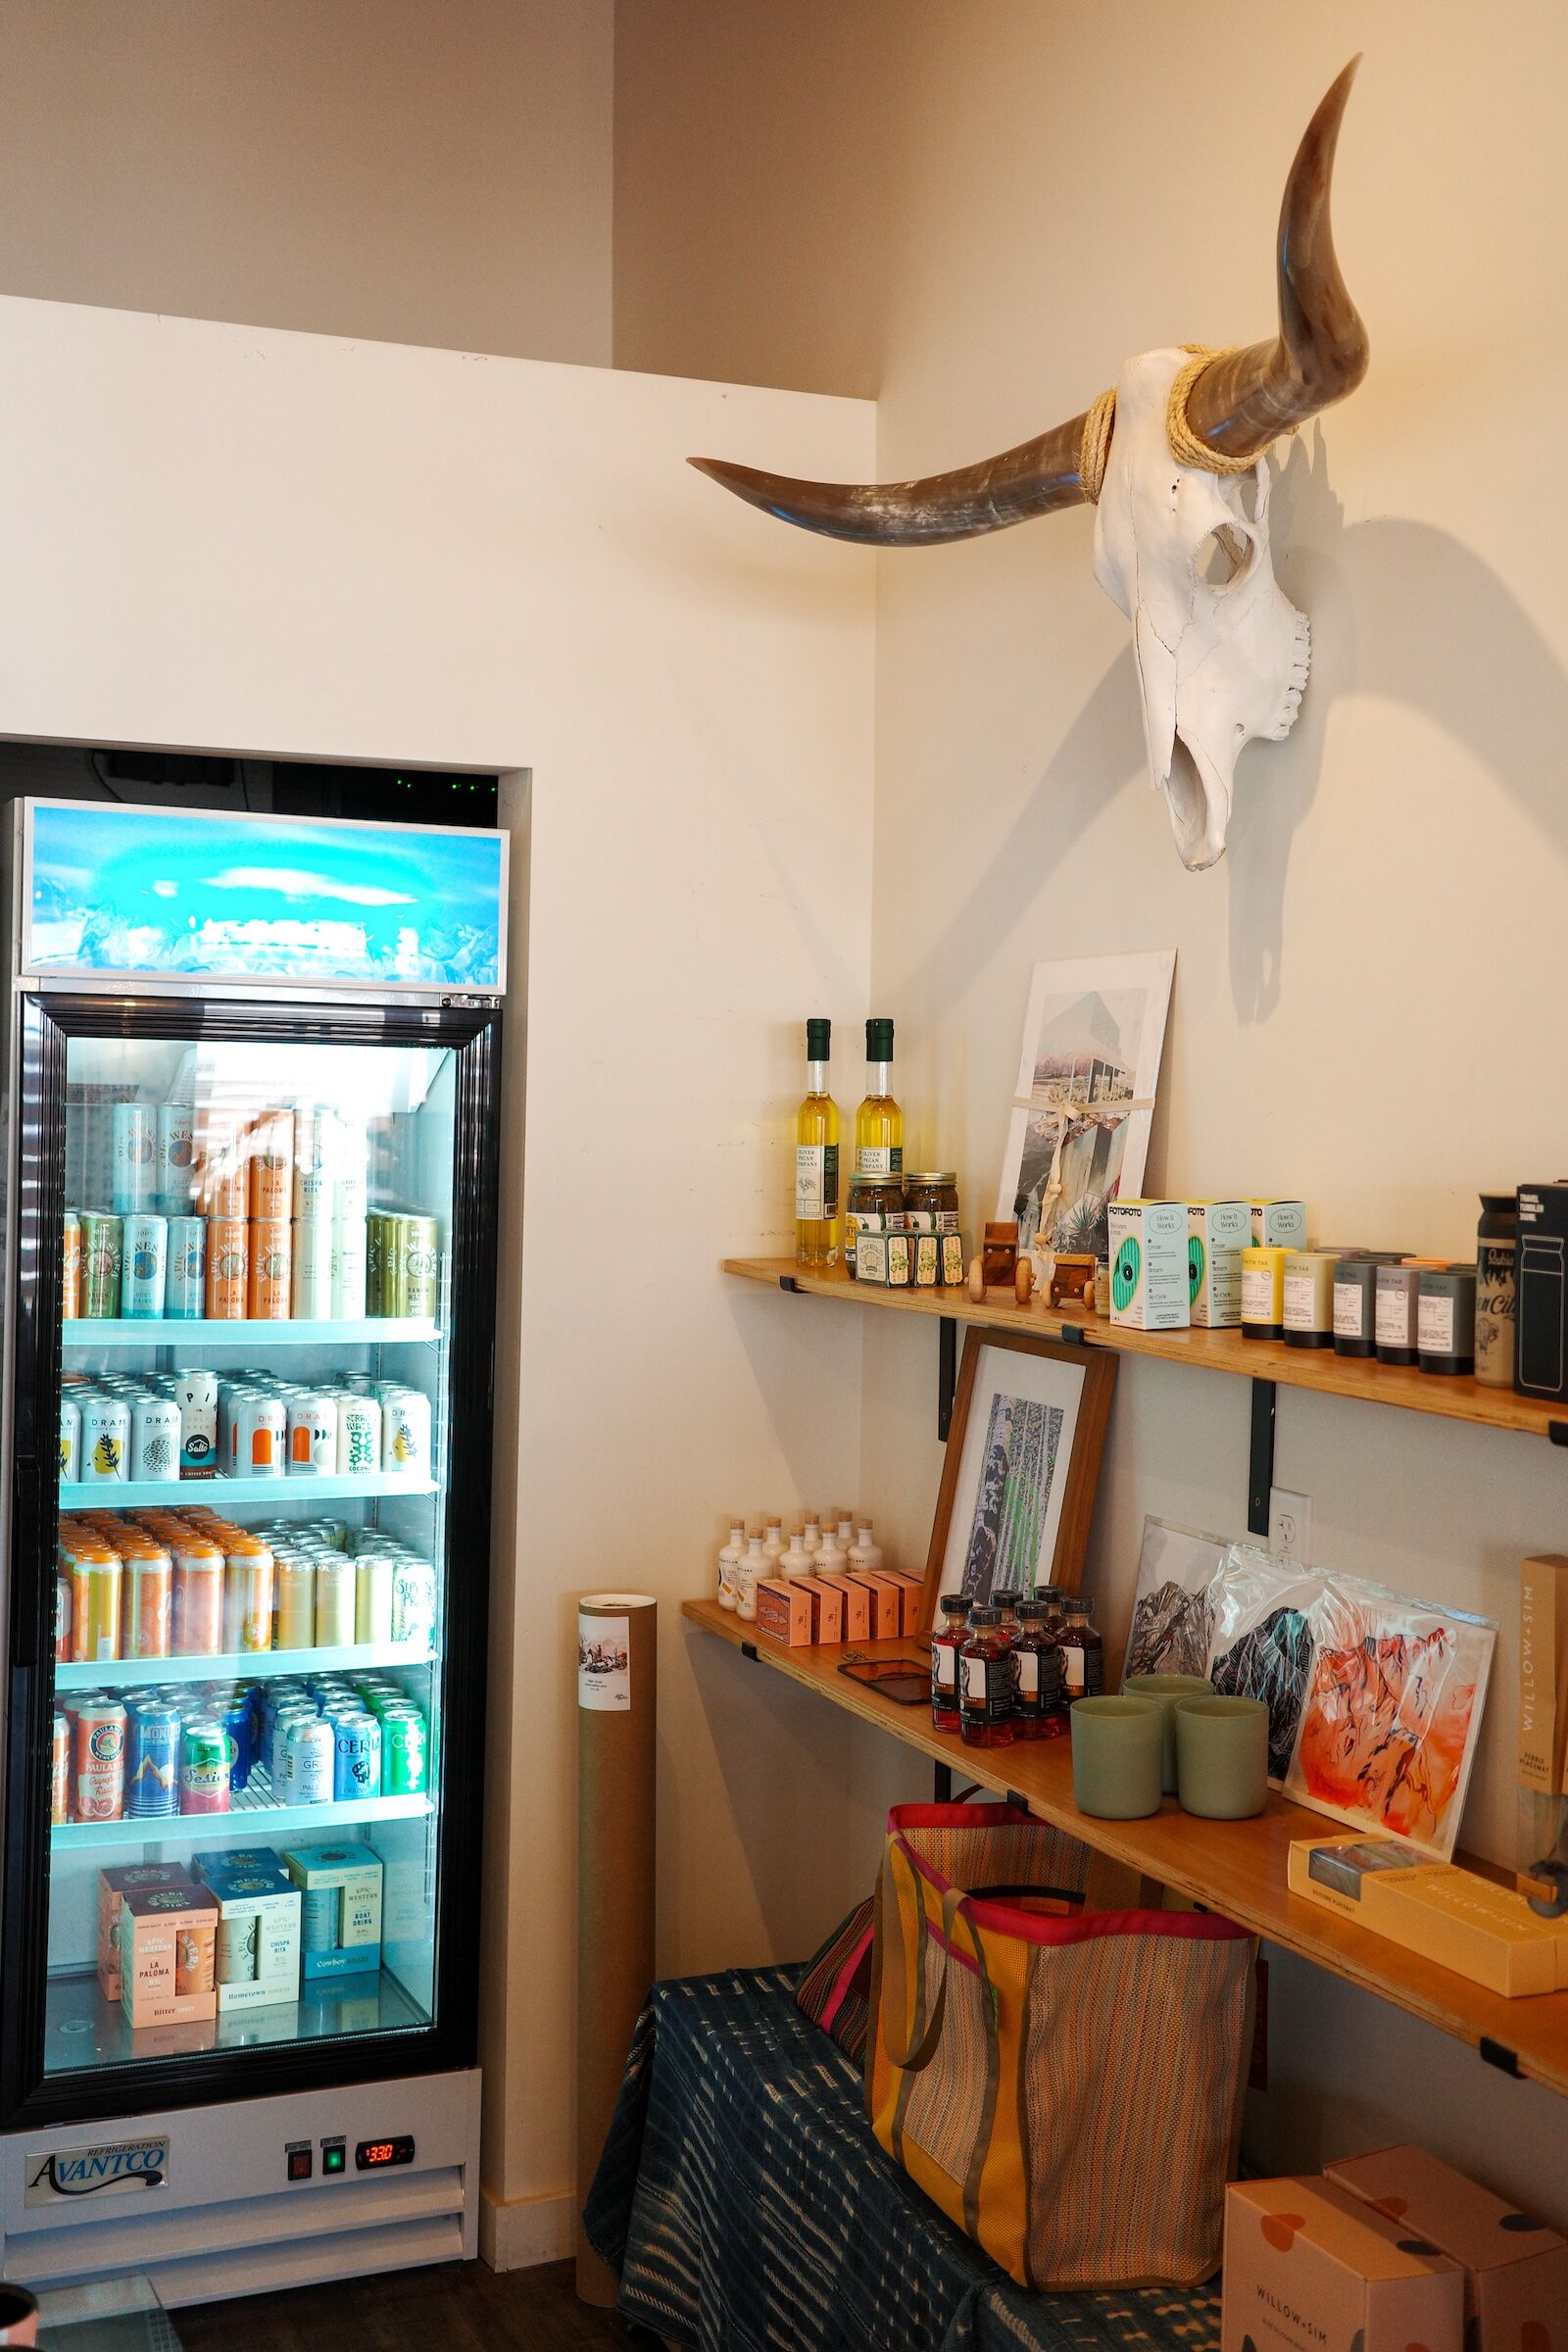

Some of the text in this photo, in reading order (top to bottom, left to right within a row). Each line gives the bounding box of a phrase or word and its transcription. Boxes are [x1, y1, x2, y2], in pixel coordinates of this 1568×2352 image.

[1108, 1206, 1143, 1216] FOTOFOTO
[92, 1418, 126, 1427] DRAM
[348, 1892, 378, 1901] WESTERN
[265, 1923, 297, 1932] WESTERN
[139, 1943, 172, 1953] WESTERN
[317, 1957, 346, 1969] Cowboy
[139, 1968, 170, 1979] PALOMA
[228, 1989, 266, 2000] Hometown
[154, 2007, 176, 2016] Bitter
[87, 2140, 166, 2157] REFRIGERATION
[27, 2148, 165, 2192] AVANTCO
